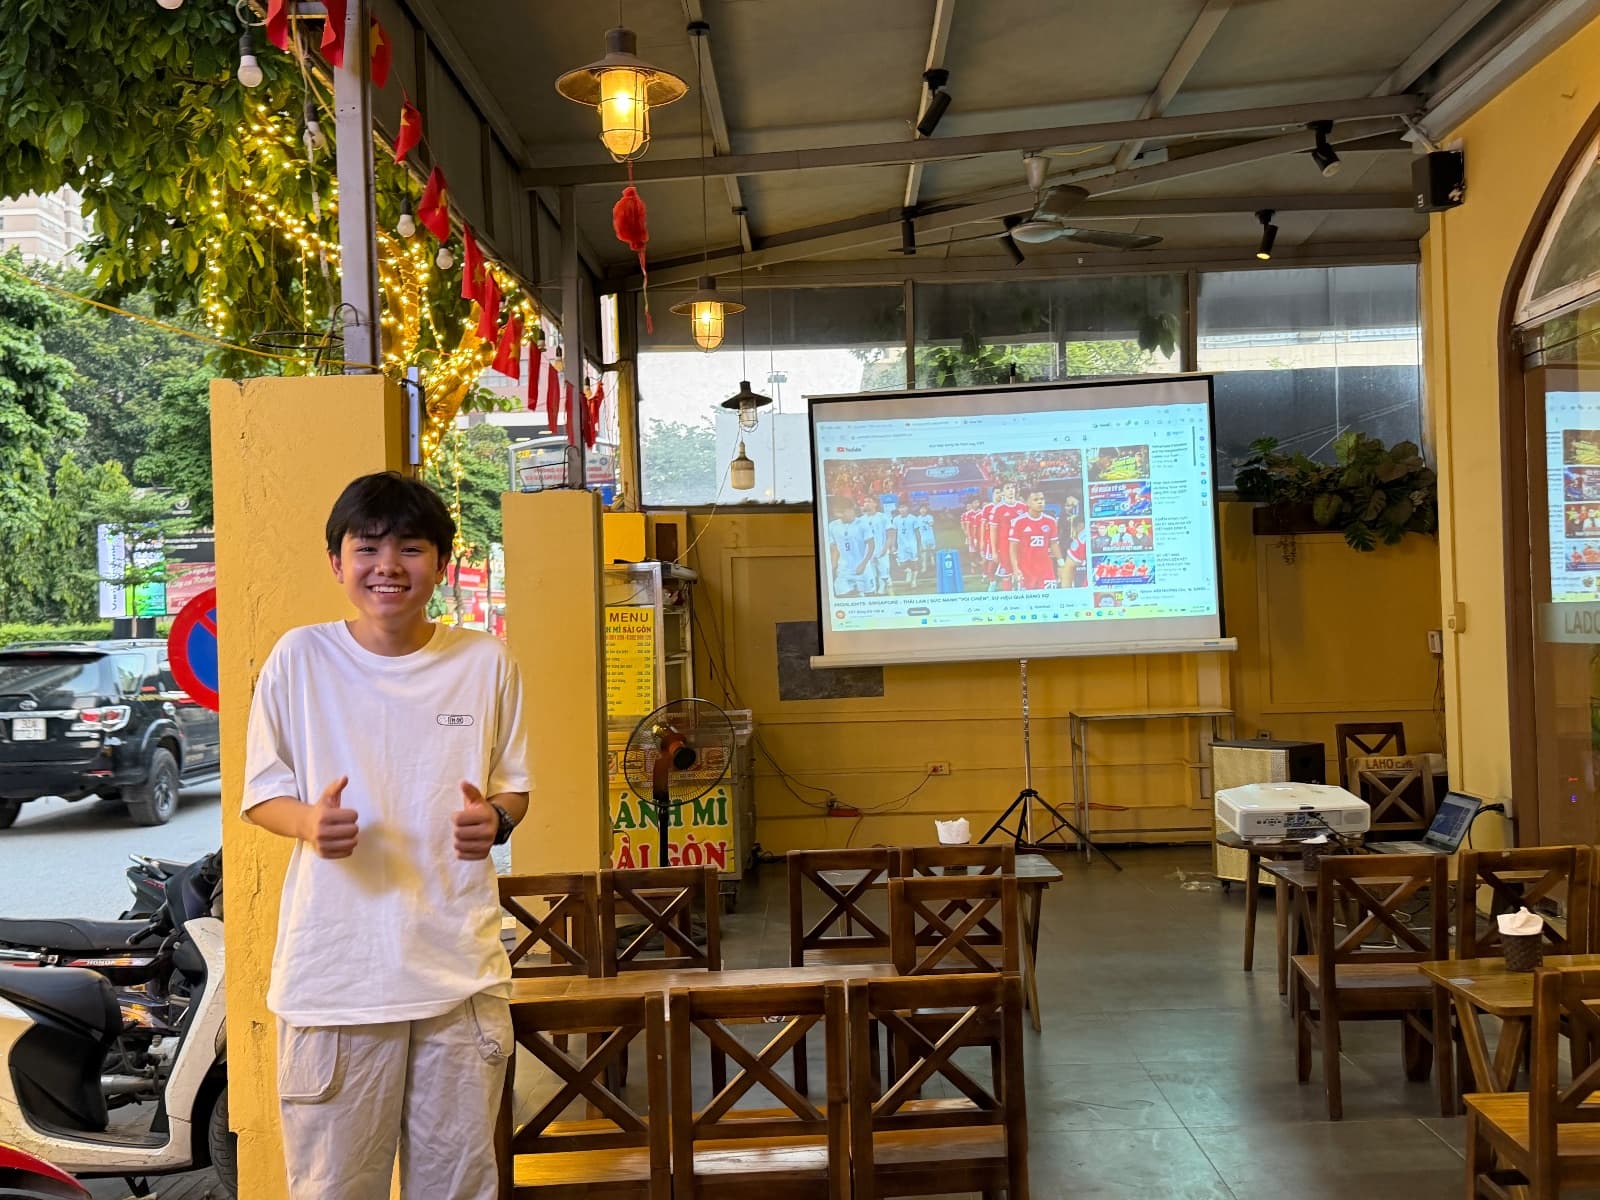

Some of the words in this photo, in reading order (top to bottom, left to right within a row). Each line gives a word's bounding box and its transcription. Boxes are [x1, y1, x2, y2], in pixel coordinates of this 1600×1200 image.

[1030, 535, 1044, 547] 26
[609, 612, 649, 622] MENU
[1366, 758, 1394, 769] LAHO
[610, 792, 684, 829] ÁNH
[692, 788, 728, 827] MÌ
[610, 836, 651, 869] ÀI
